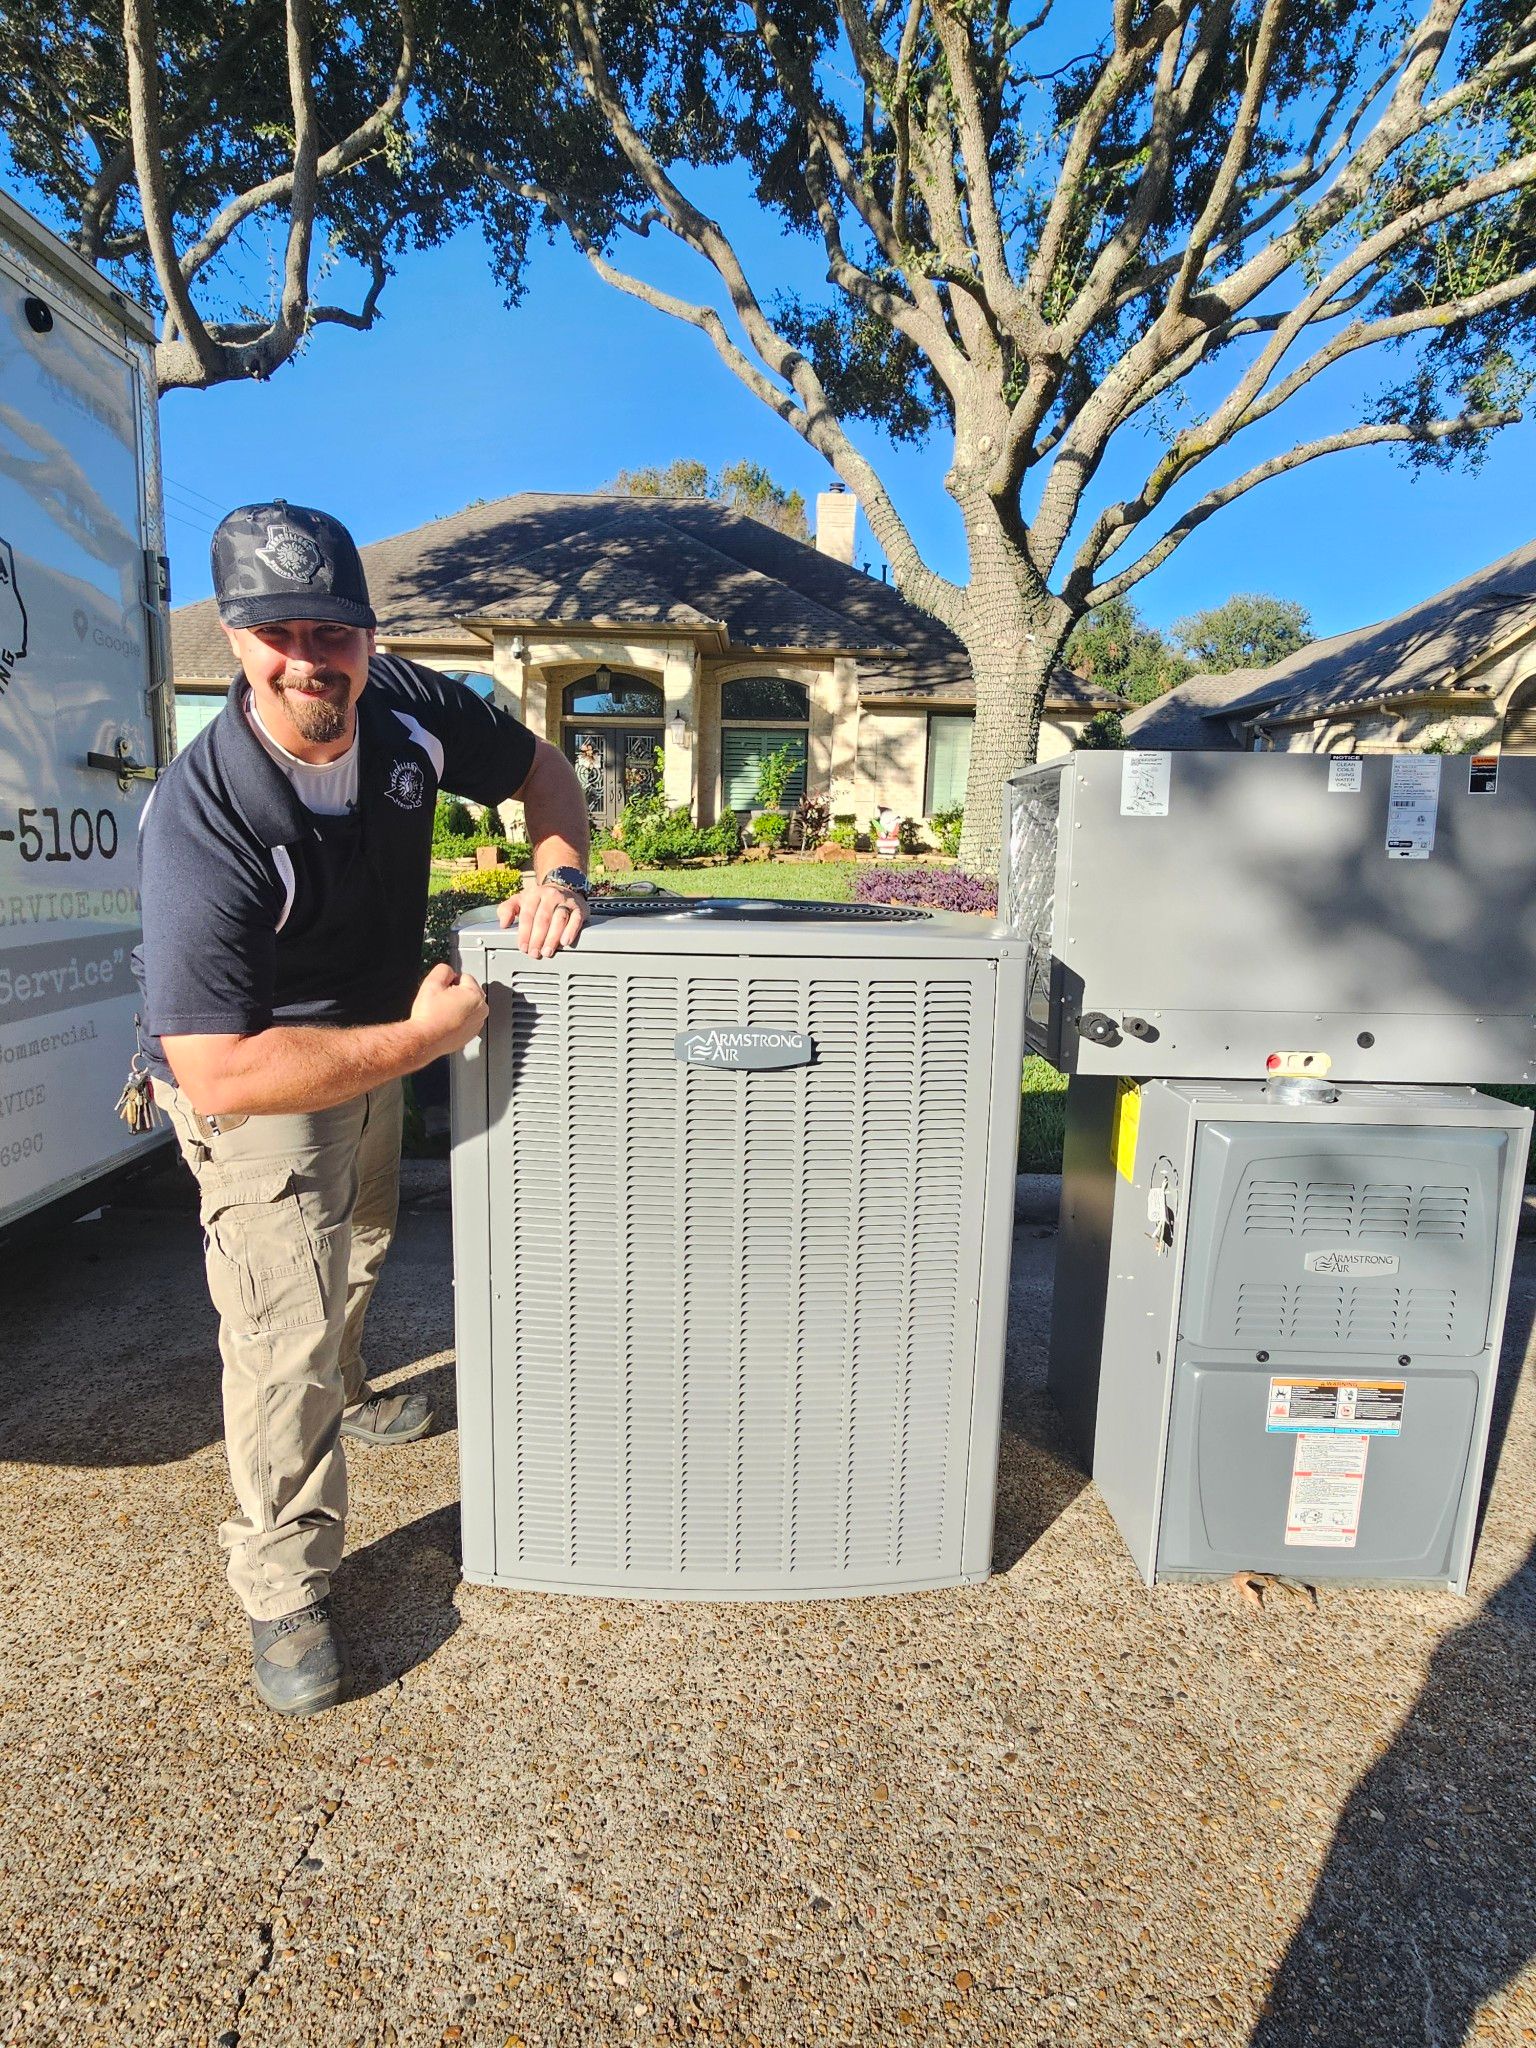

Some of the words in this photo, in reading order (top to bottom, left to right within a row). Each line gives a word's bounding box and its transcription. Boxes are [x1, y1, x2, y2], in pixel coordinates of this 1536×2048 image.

[93, 628, 141, 657] Google
[705, 1030, 803, 1048] ARMSTRONG
[711, 1045, 739, 1061] AIR
[0, 1084, 46, 1119] VICE
[1328, 1253, 1393, 1264] ARMSTRONG
[1331, 1262, 1350, 1272] AIR
